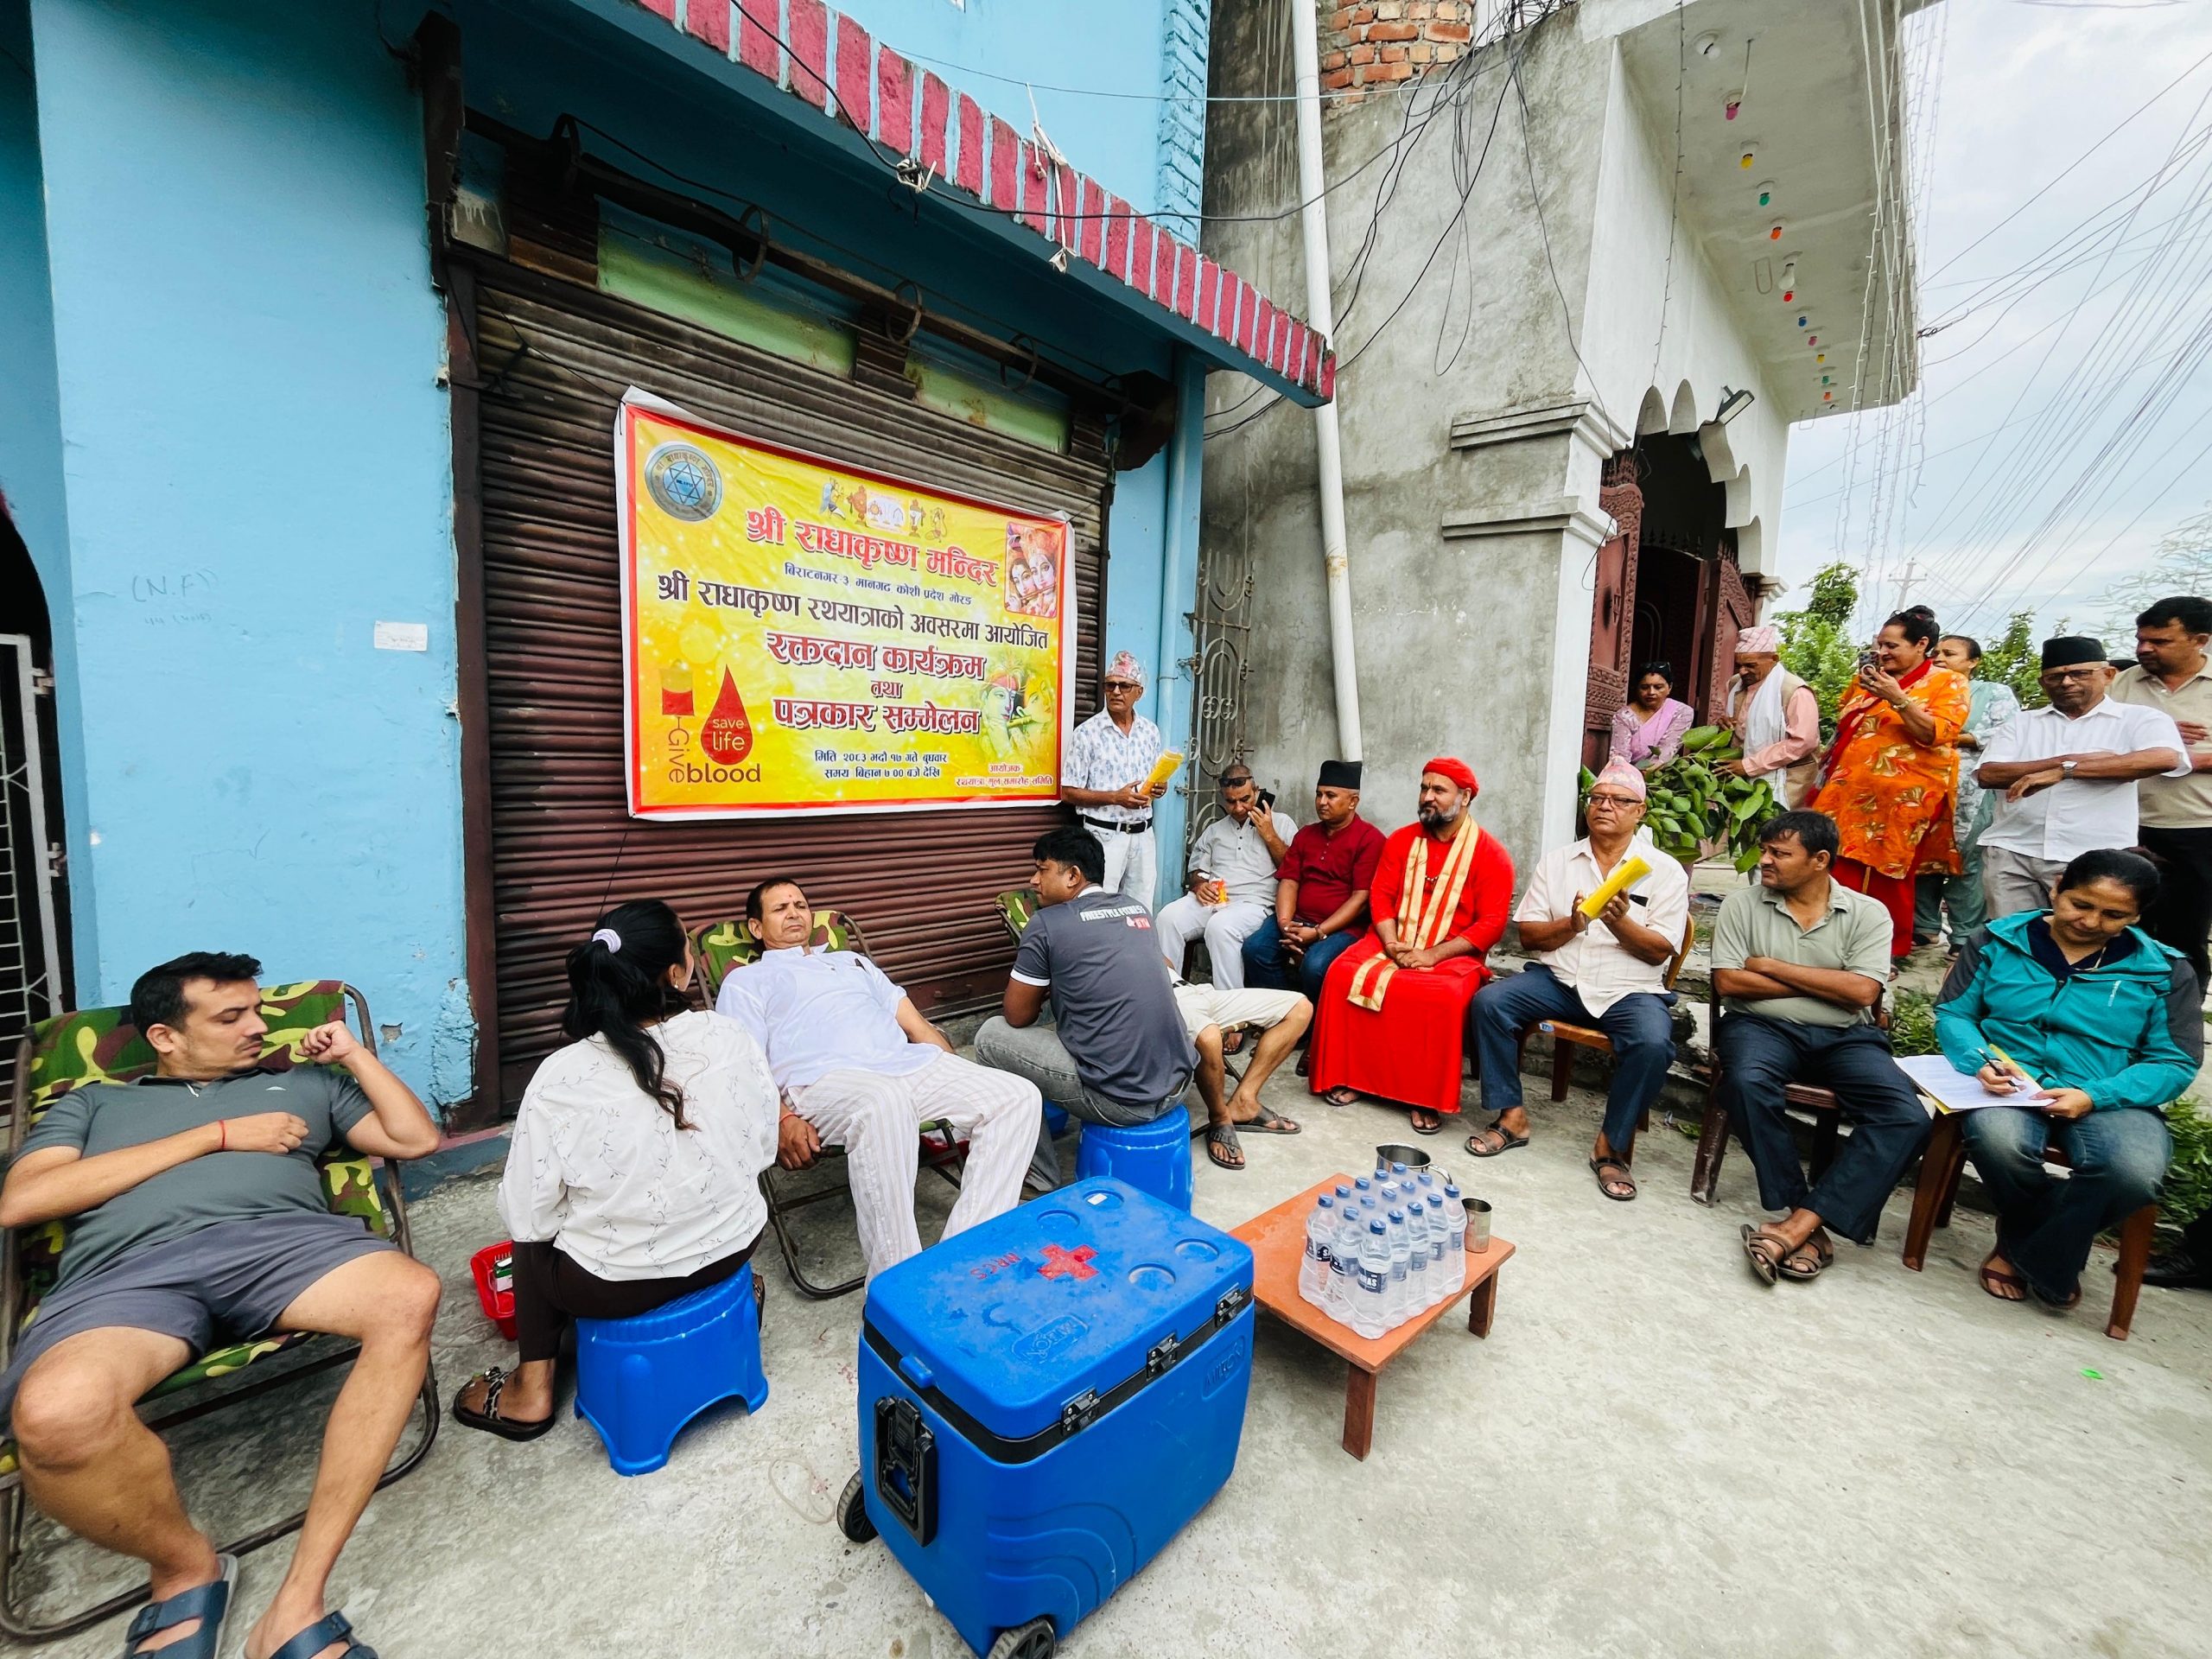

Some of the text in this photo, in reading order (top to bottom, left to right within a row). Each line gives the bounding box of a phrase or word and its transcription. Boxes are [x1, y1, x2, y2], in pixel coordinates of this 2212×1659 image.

[747, 505, 999, 586] श्री राधाकृष्ण मन्दिर
[896, 582, 920, 597] कोशी
[924, 588, 944, 601] प्रदेश
[658, 569, 1048, 649] श्री राधाकृष्ण रथयात्राको अवसरमा आयोजित
[766, 632, 986, 680] रक्तदान कार्यक्रम
[870, 679, 903, 699] तथा
[712, 718, 744, 729] save
[772, 698, 982, 734] पत्रकार सम्मेलन
[712, 731, 745, 752] life
[668, 728, 761, 783] Give blood
[843, 753, 867, 763] २०८३
[891, 753, 902, 762] १७
[905, 751, 918, 762] गते
[906, 766, 920, 778] बजे
[923, 766, 940, 778] देखि
[1031, 775, 1052, 785] समिति
